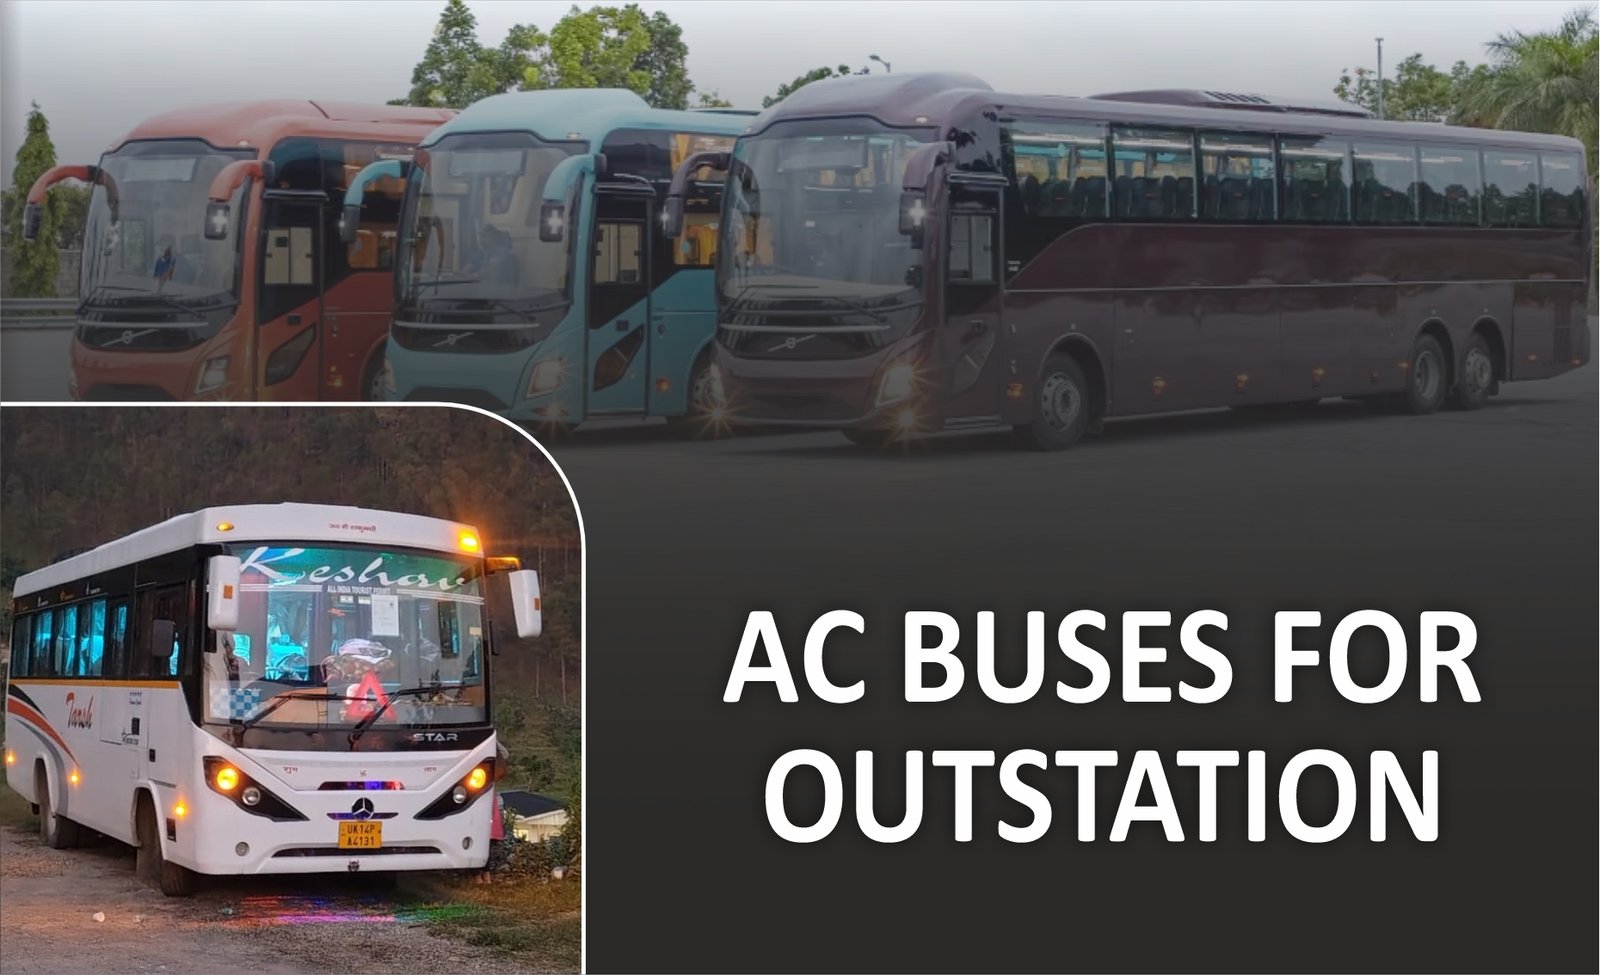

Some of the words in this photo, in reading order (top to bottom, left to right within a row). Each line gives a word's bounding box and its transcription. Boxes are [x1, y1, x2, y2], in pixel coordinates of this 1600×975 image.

[240, 546, 465, 591] Keshav
[327, 585, 337, 593] ALL
[352, 586, 371, 595] TOURIST
[413, 733, 458, 741] STAR
[347, 824, 375, 834] UK14P
[347, 836, 375, 846] A4131
